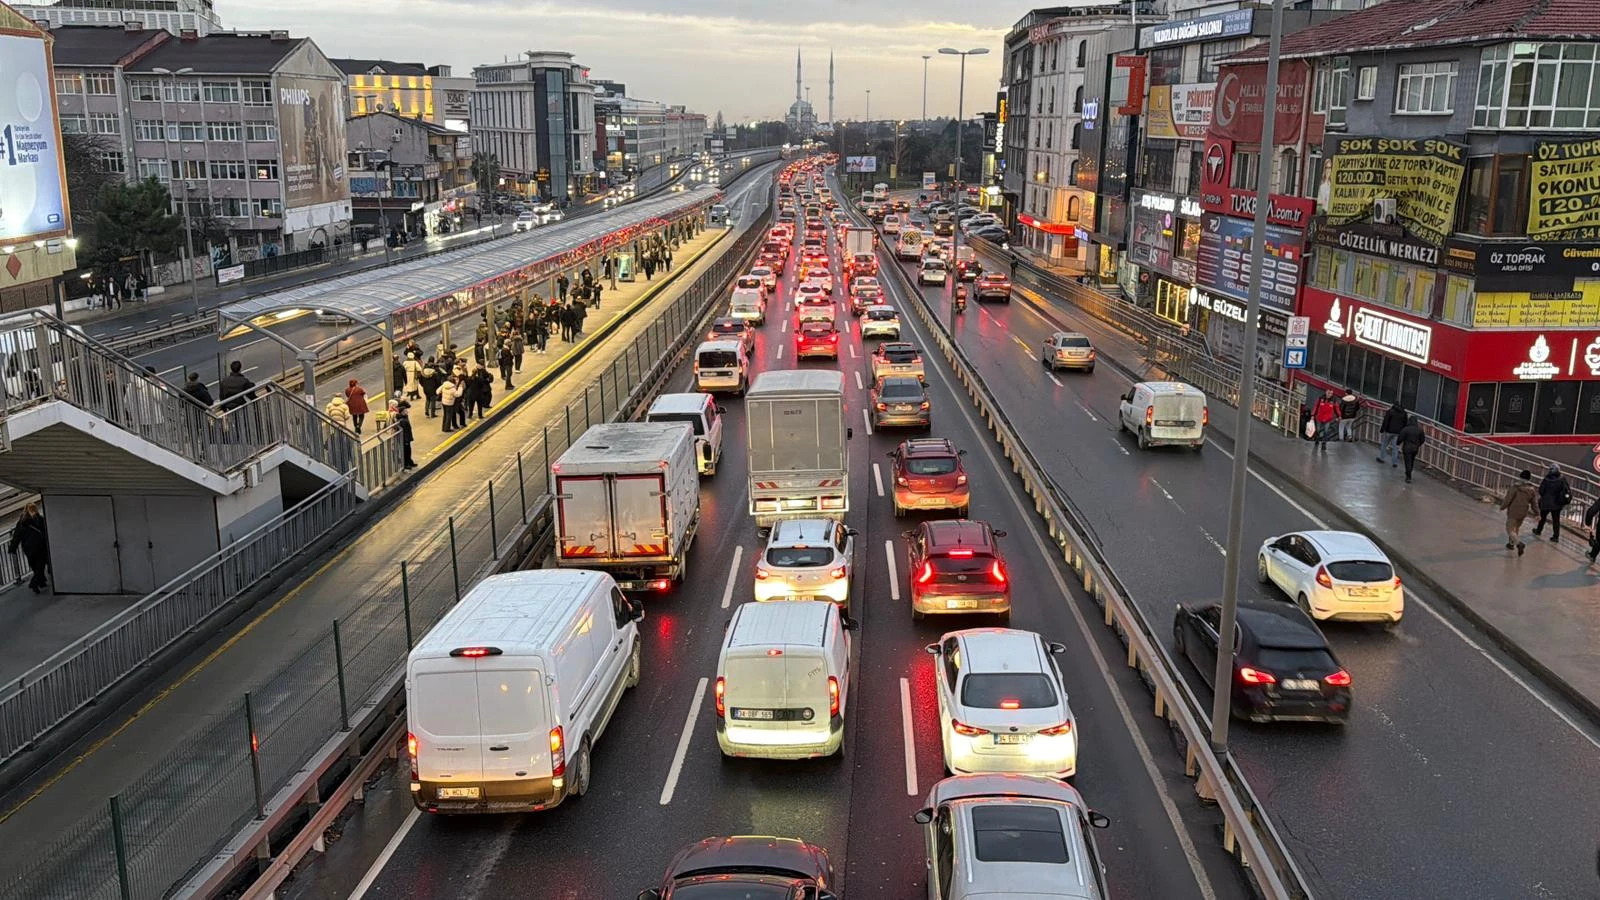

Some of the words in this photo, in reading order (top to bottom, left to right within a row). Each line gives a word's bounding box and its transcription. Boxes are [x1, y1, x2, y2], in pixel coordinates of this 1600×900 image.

[1179, 21, 1199, 40] DÜĞÜN
[1198, 19, 1223, 37] SALONU
[280, 87, 311, 106] PHILIPS
[16, 140, 48, 152] Magnezyum
[1340, 138, 1372, 153] ŞOK
[1377, 138, 1417, 153] ŞOK
[1424, 139, 1462, 160] ŞOK
[1538, 141, 1559, 160] ÖZ
[18, 153, 39, 163] Markası
[1388, 156, 1400, 170] ÖZ
[1539, 160, 1595, 177] SATILIK
[1376, 173, 1385, 184] TL
[1387, 174, 1409, 186] GETİR
[1581, 227, 1595, 239] 34
[1339, 230, 1386, 254] GÜZELLİK
[1389, 240, 1439, 265] MERKEZİ
[1490, 251, 1503, 264] ÖZ
[1505, 253, 1546, 264] TOPRAK
[1518, 264, 1534, 272] OFİSİ
[1197, 292, 1213, 310] NİL
[1382, 320, 1427, 357] LOKANTASI
